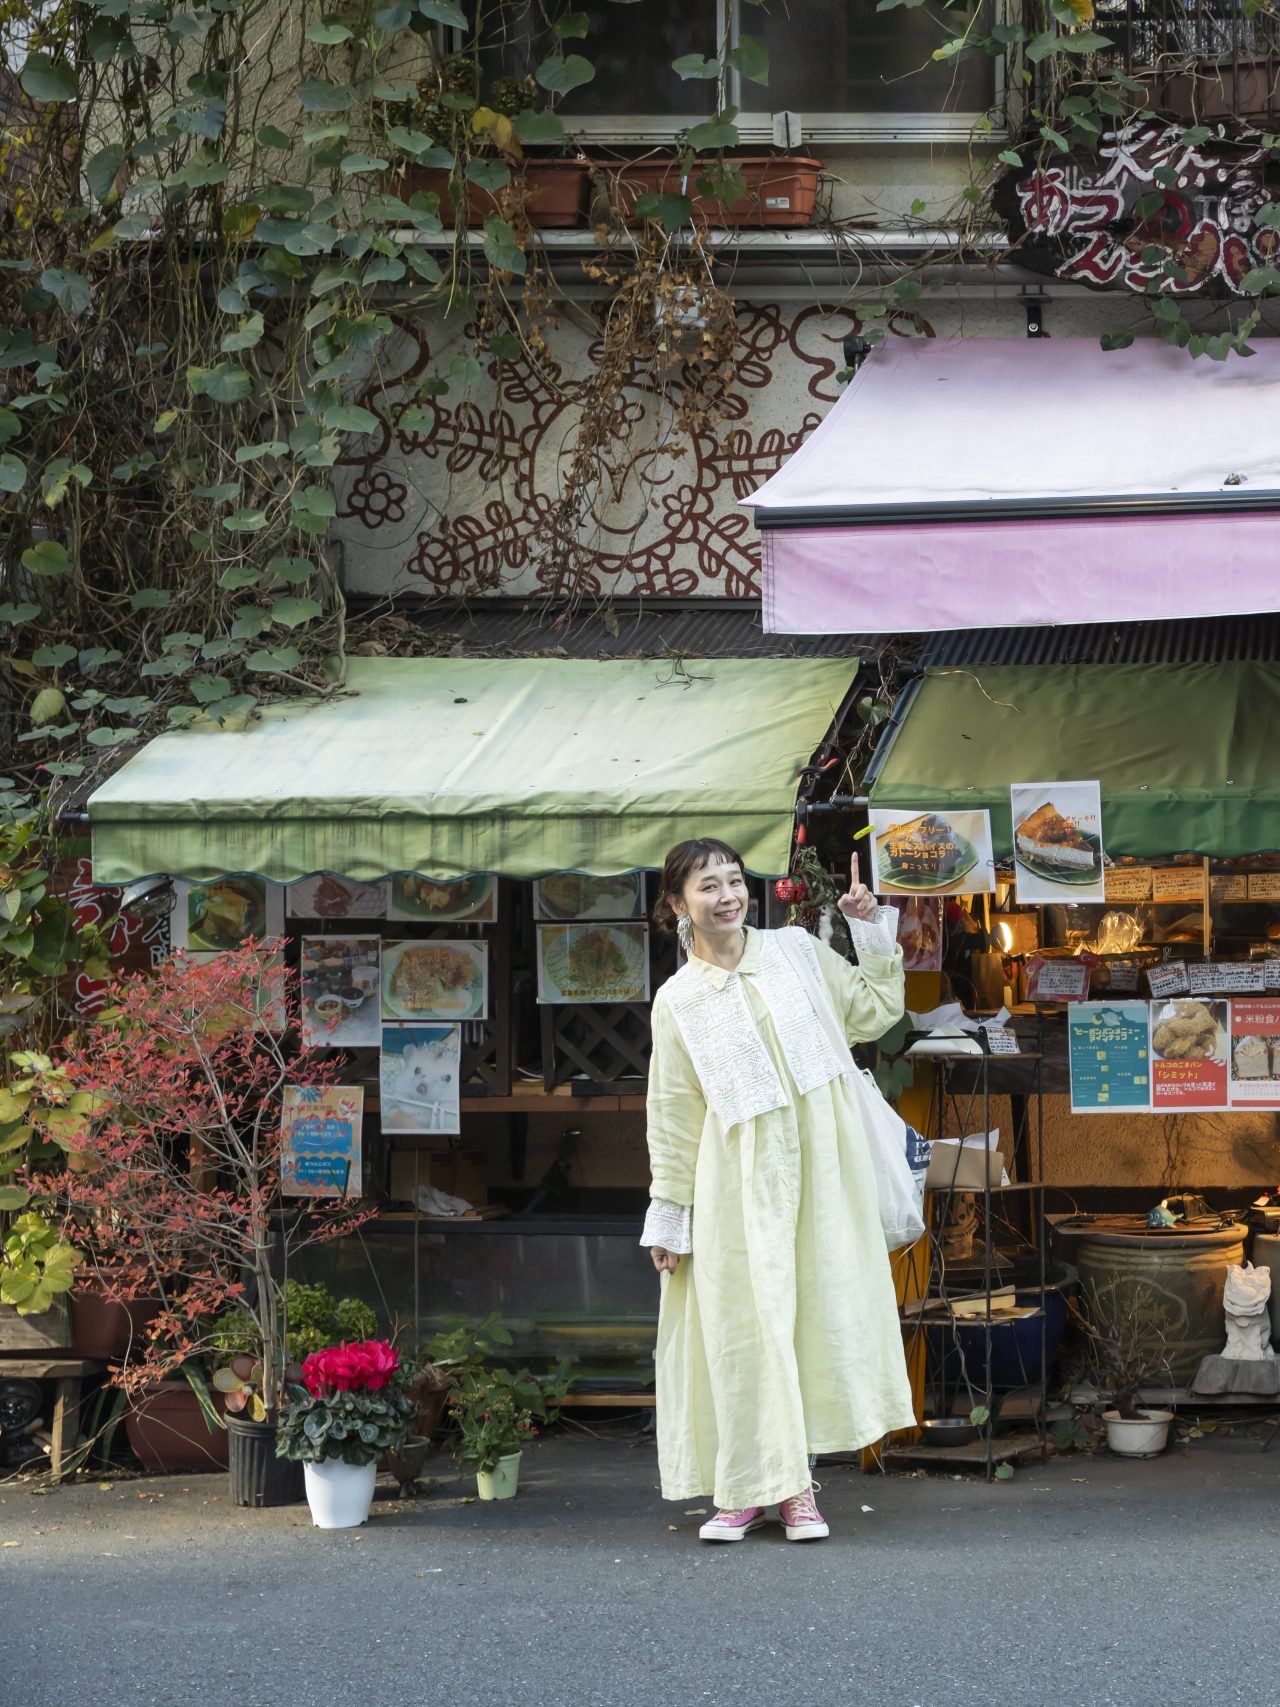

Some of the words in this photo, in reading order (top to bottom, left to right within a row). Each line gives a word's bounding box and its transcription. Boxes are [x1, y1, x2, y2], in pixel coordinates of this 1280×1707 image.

[1154, 1061, 1203, 1070] トルコのごまパン
